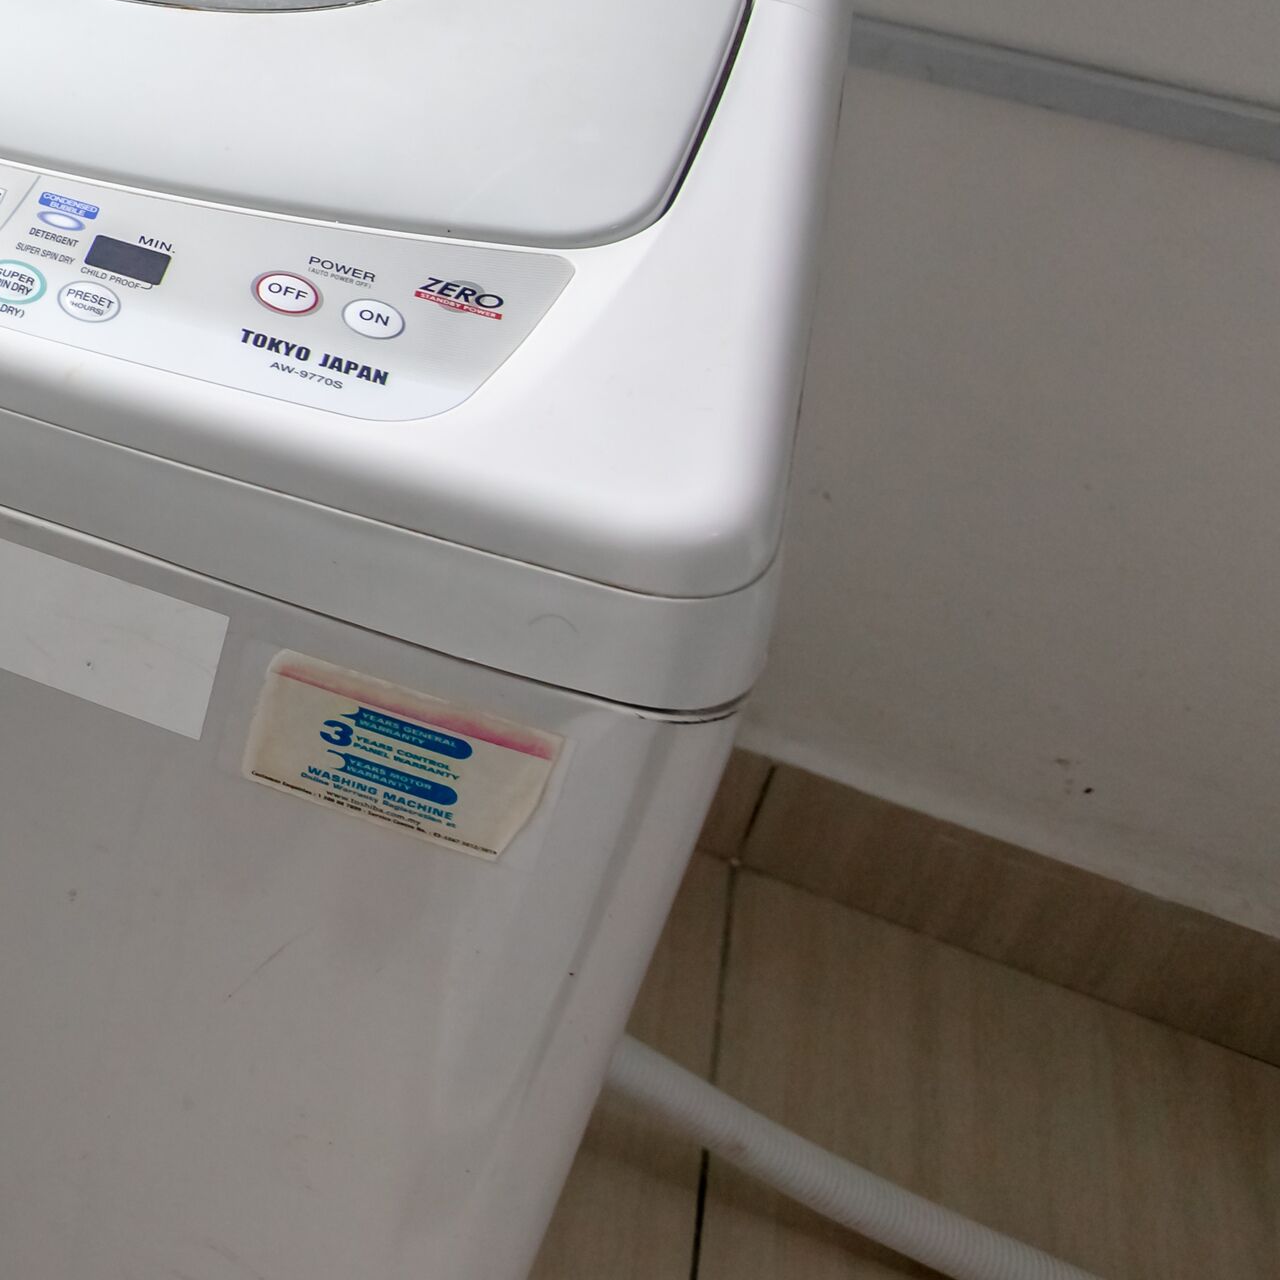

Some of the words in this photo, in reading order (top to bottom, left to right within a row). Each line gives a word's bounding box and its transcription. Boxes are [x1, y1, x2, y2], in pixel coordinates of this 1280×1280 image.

[43, 192, 98, 212] CONDENSED
[49, 201, 86, 217] BUBBLE
[29, 227, 79, 248] DETERGENT
[138, 235, 176, 253] MIN.
[15, 242, 40, 255] SUPER
[40, 249, 60, 261] SPIN
[60, 254, 76, 265] DRY
[80, 267, 108, 280] CHILD
[109, 275, 141, 290] PROOF
[308, 256, 376, 282] POWER
[308, 267, 329, 278] (AUTO
[330, 273, 354, 285] POWER
[355, 278, 372, 289] OFF)
[10, 282, 33, 296] DRY
[66, 288, 115, 309] PRESET
[267, 282, 309, 302] OFF
[419, 277, 504, 309] ZERO
[0, 303, 25, 318] DRY)
[69, 300, 105, 317] HOURS)
[359, 309, 390, 327] ON
[420, 293, 461, 309] STANDBY
[463, 306, 497, 319] POWER
[240, 328, 311, 362] TOKYO
[318, 353, 389, 386] JAPAN
[270, 361, 344, 390] AW-9770S
[319, 720, 354, 746] 3
[359, 720, 425, 745] WARRANTY
[362, 712, 400, 730] YEARS
[403, 724, 456, 748] GENERAL
[353, 742, 390, 759] PANEL
[393, 755, 460, 780] WARRANTY
[356, 735, 393, 752] YEARS
[396, 749, 451, 771] CONTROL
[347, 766, 412, 791] WARRANTY
[349, 759, 386, 776] YEARS
[389, 772, 432, 790] MOTOR
[307, 766, 378, 795] WASHING
[383, 792, 454, 820] MACHINE
